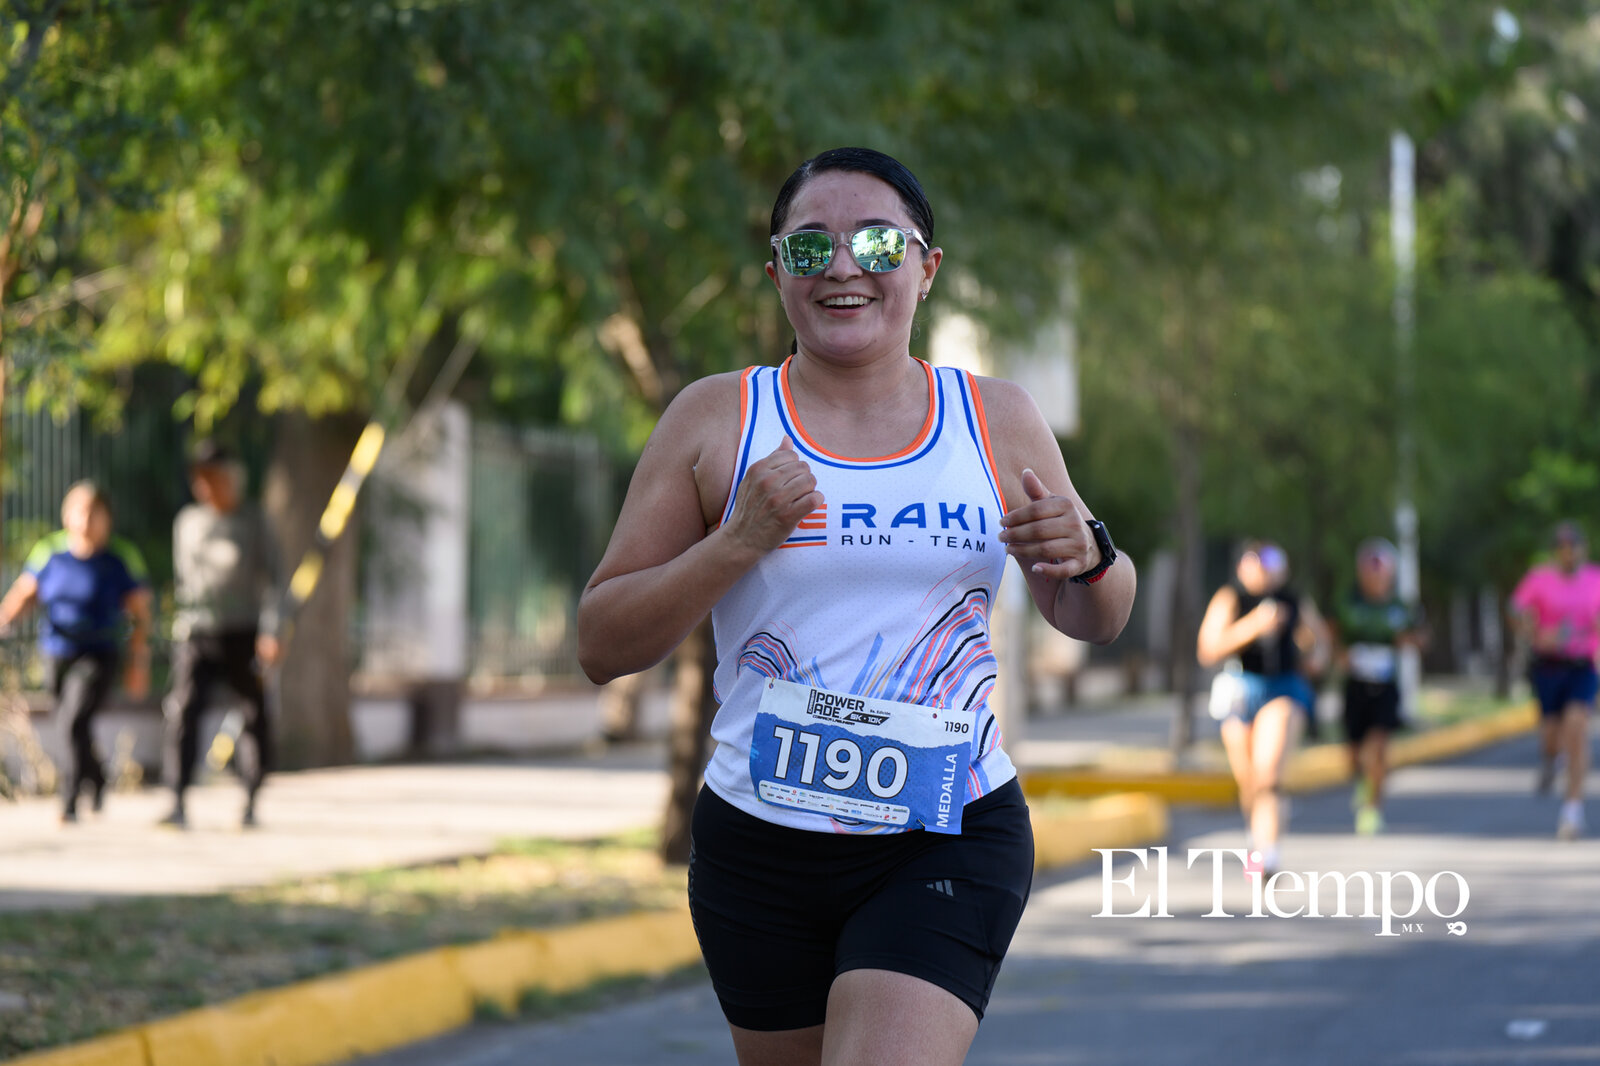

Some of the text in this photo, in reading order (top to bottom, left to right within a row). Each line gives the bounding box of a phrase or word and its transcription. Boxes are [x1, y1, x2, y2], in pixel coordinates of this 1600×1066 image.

[841, 535, 891, 546] RUN
[930, 535, 986, 553] TEAM
[816, 692, 865, 711] POWER
[944, 721, 969, 734] 1190
[773, 725, 909, 799] 1190
[936, 753, 958, 828] MEDALLA
